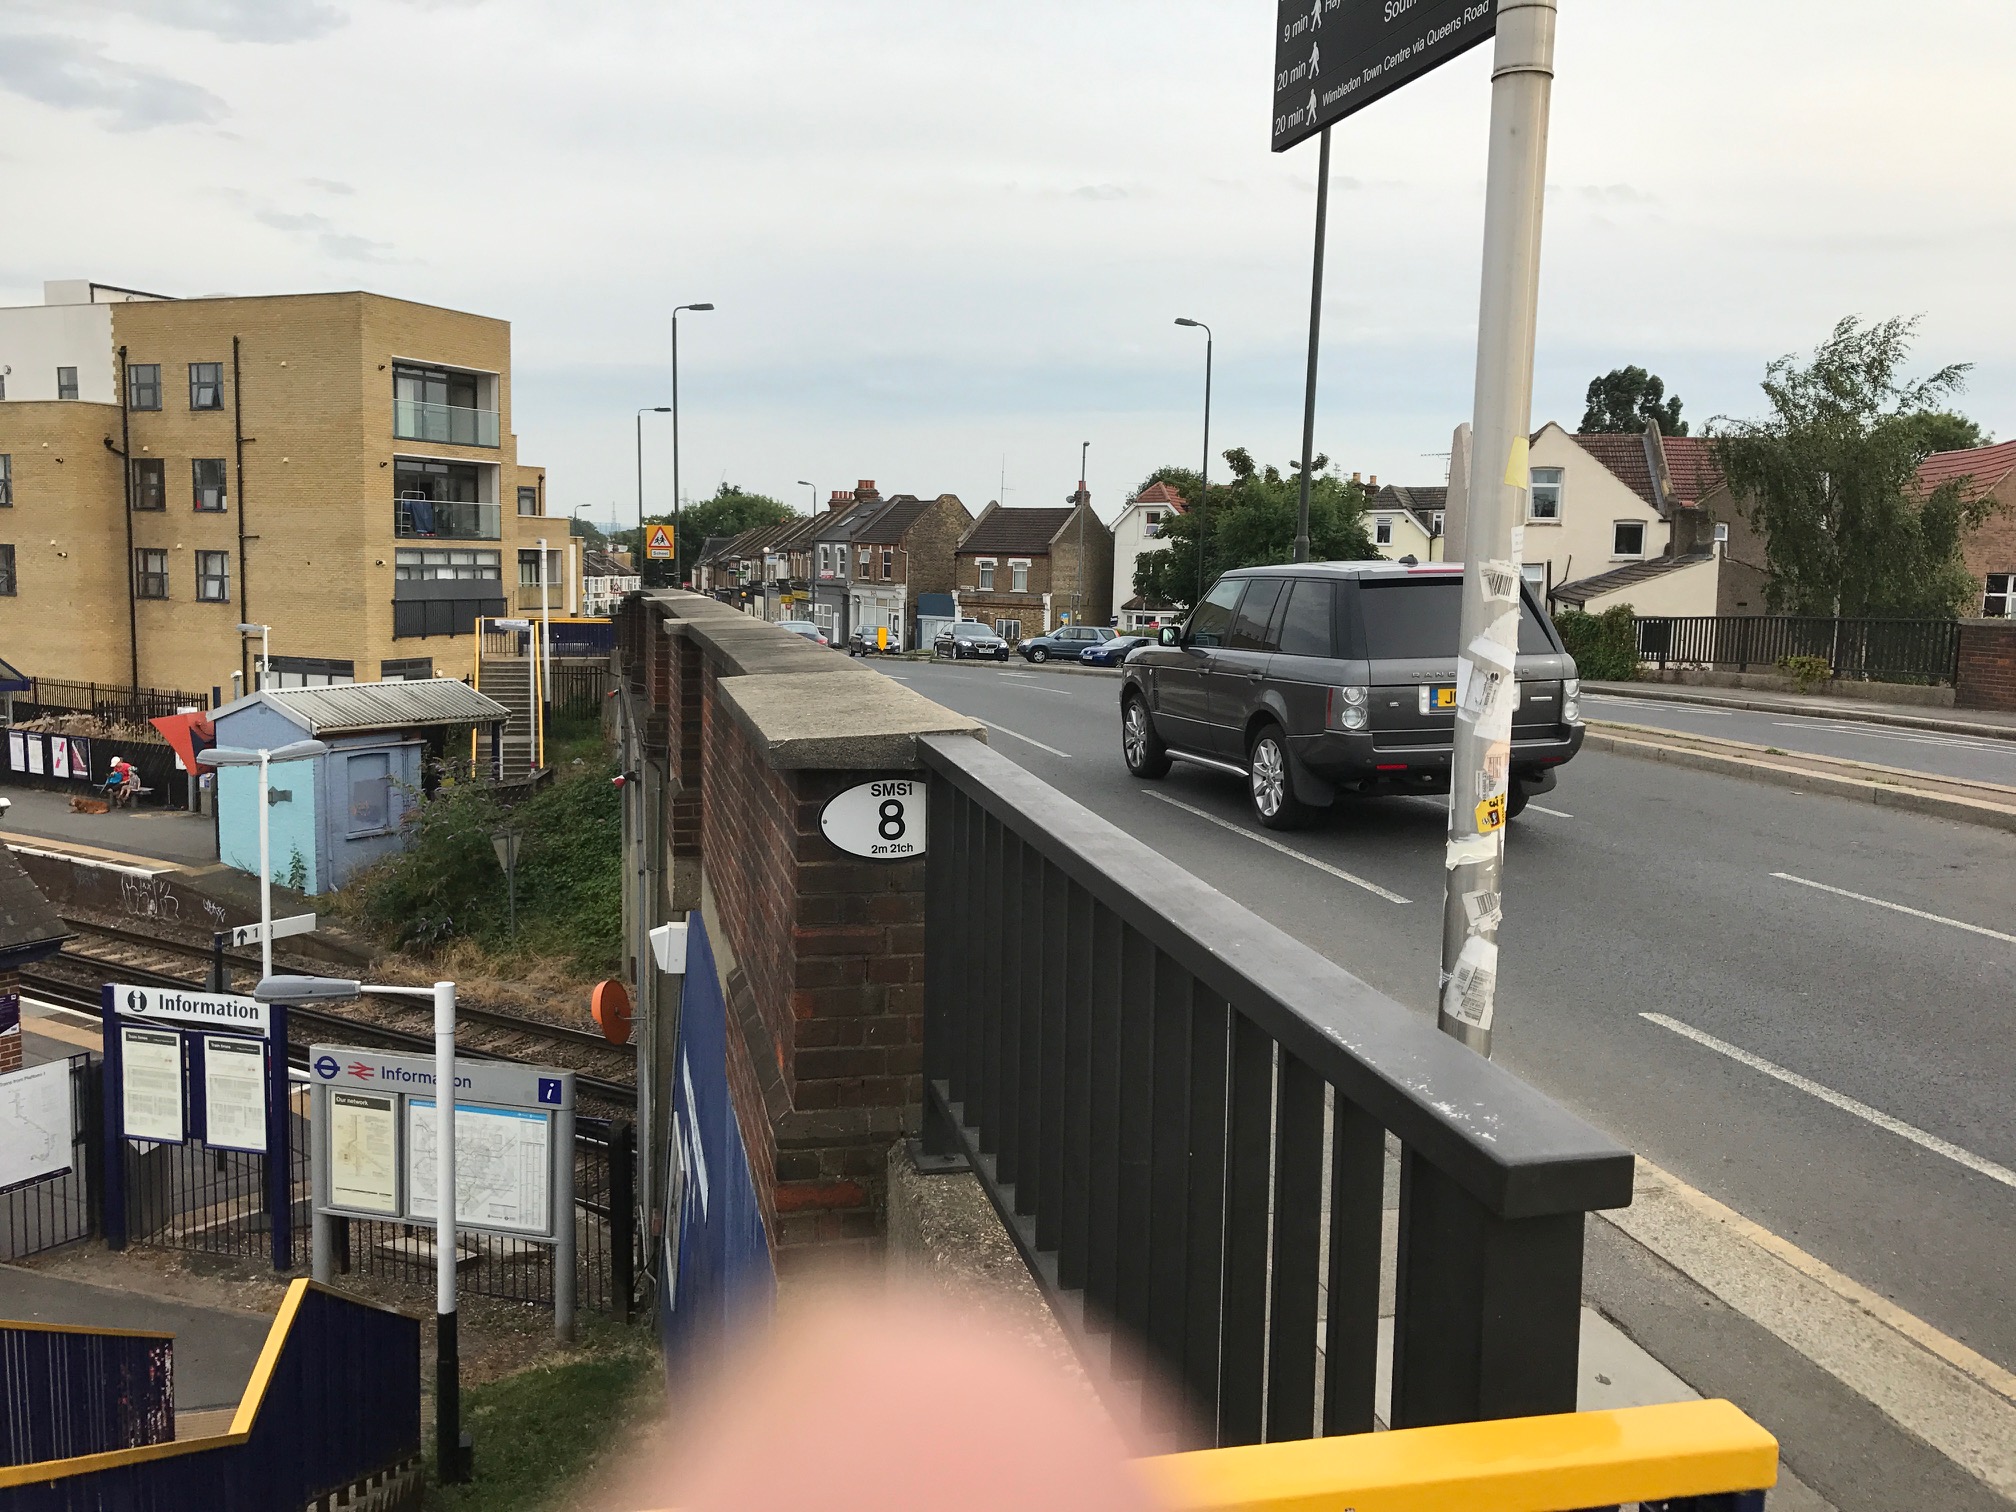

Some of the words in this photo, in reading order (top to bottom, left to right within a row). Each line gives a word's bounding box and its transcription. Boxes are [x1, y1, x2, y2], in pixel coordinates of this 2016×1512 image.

[1284, 24, 1291, 42] 9
[1292, 13, 1308, 38] min
[1277, 69, 1288, 92] 20
[1290, 60, 1306, 83] min
[1384, 0, 1417, 22] Sou
[1275, 114, 1286, 136] 20
[1288, 106, 1304, 128] min
[1322, 76, 1361, 106] Wimbledon
[1362, 64, 1382, 83] Town
[1384, 47, 1410, 70] Centre
[1413, 37, 1425, 54] via
[1426, 16, 1461, 46] Queens
[1463, 0, 1489, 25] Road
[871, 783, 913, 797] SMS1
[878, 799, 906, 841] 8
[871, 845, 888, 854] 2m
[890, 843, 914, 853] 21ch
[253, 927, 258, 938] 1
[159, 994, 259, 1020] Information
[382, 1066, 472, 1088] Informon
[347, 1098, 369, 1106] network
